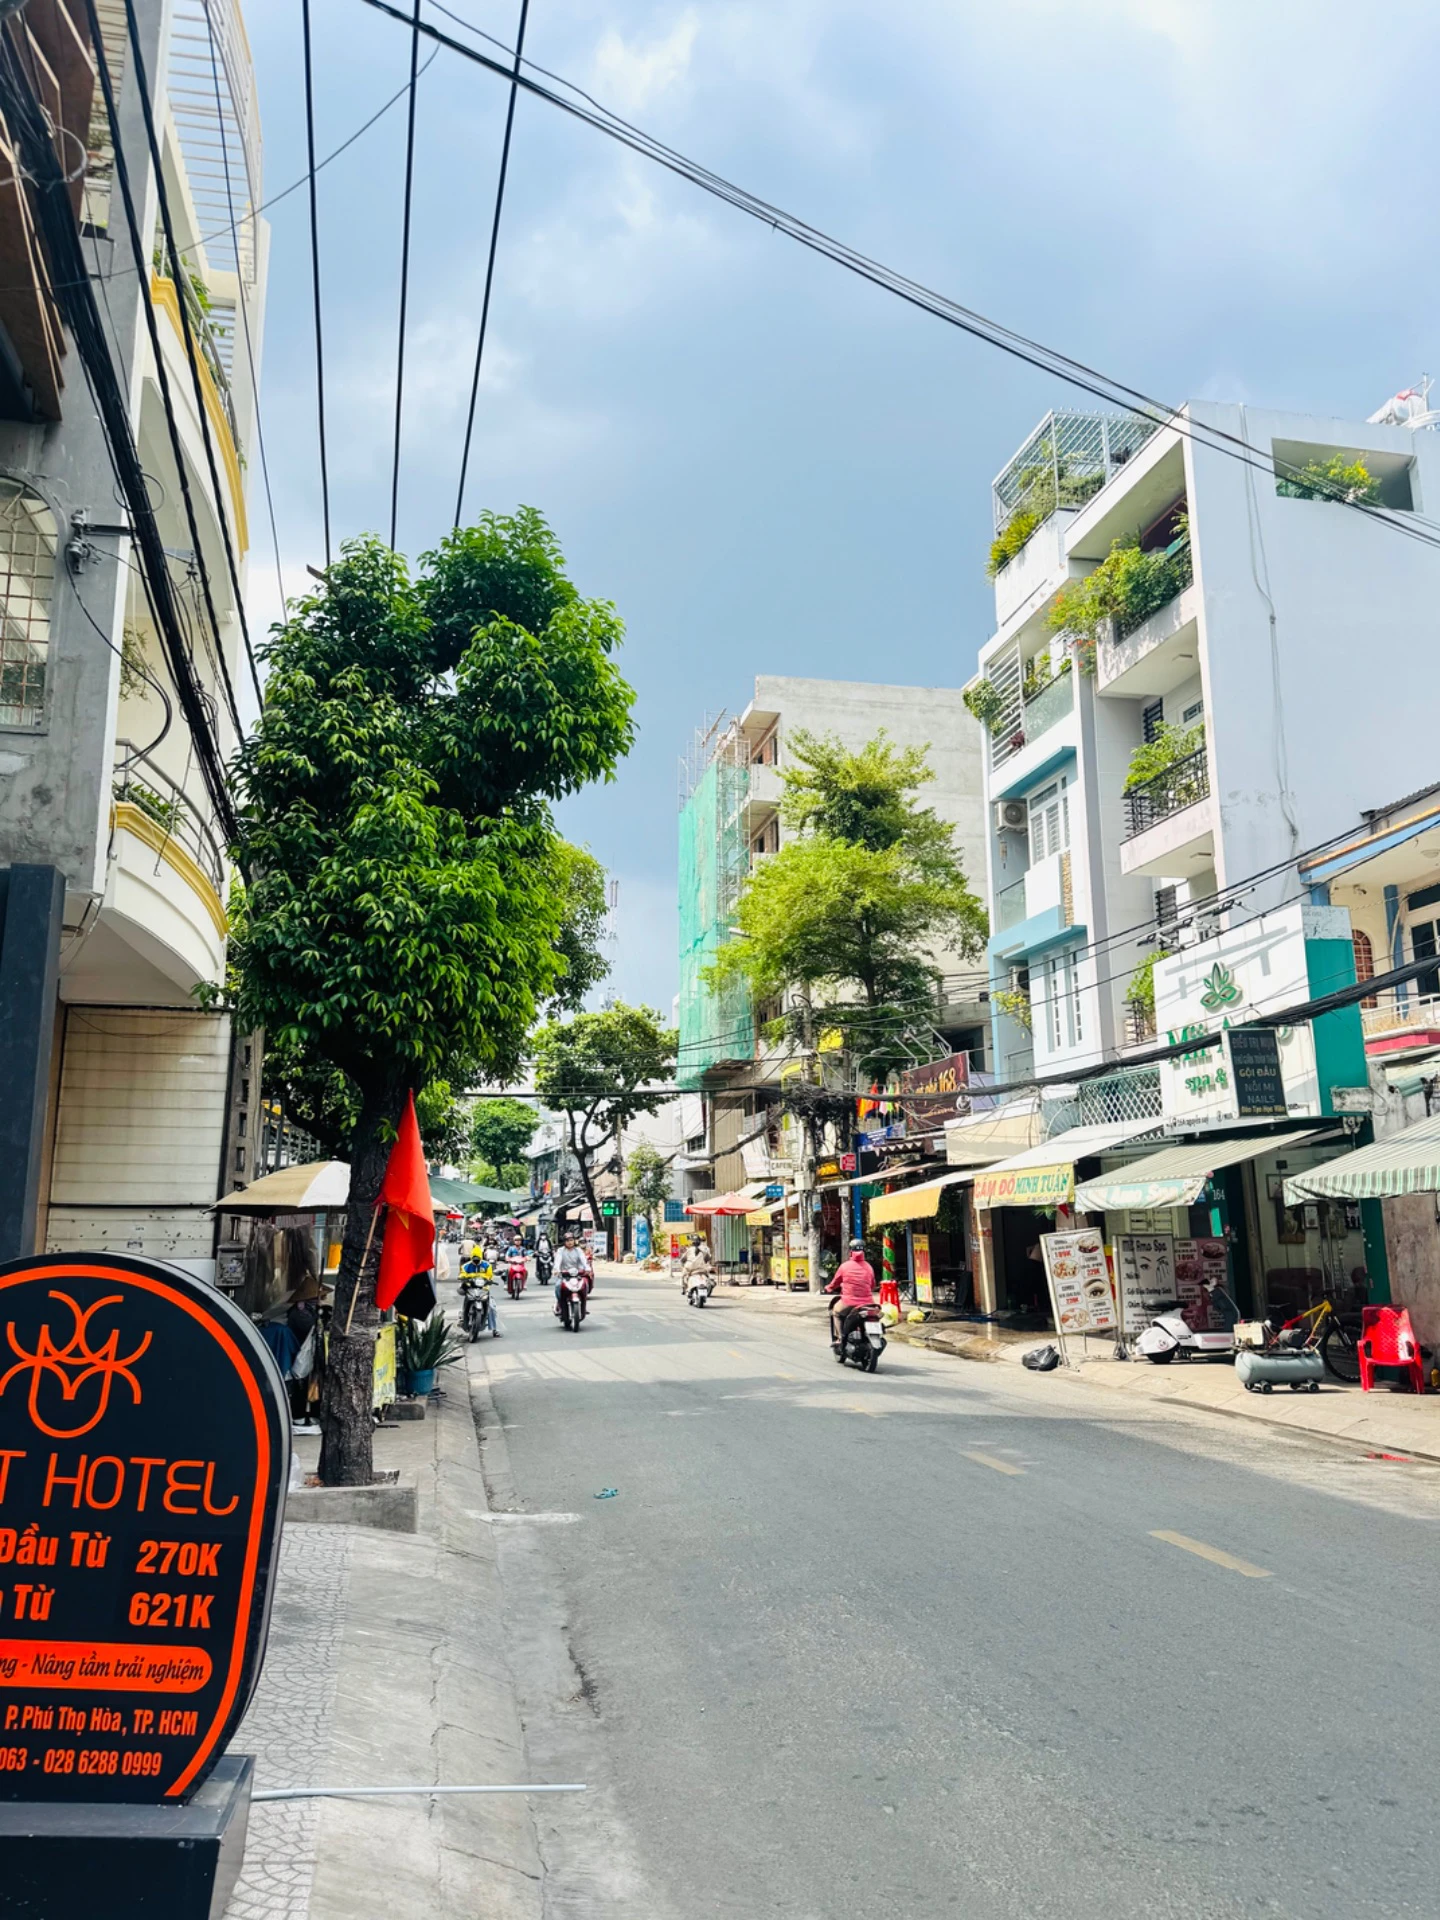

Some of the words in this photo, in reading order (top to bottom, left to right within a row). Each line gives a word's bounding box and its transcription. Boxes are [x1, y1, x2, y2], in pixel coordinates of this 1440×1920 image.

[1185, 1075, 1210, 1091] spa
[1239, 1067, 1255, 1078] GỘI
[1248, 1095, 1276, 1104] NAILS
[43, 1453, 239, 1515] HOTEL
[0, 1523, 58, 1565] Đầu
[70, 1532, 111, 1568] Từ
[136, 1541, 222, 1576] 270K
[14, 1584, 55, 1621] Từ
[129, 1592, 214, 1629] 621K
[31, 1654, 75, 1680] Nâng
[79, 1651, 110, 1677] tầm
[114, 1655, 145, 1678] trải
[146, 1659, 204, 1685] nghiệm
[58, 1706, 87, 1736] Thọ
[89, 1707, 127, 1736] Hòa,
[133, 1709, 154, 1734] TP.
[158, 1711, 198, 1736] HCM
[44, 1749, 75, 1773] 028
[78, 1750, 119, 1775] 6288
[121, 1752, 162, 1777] 0999
